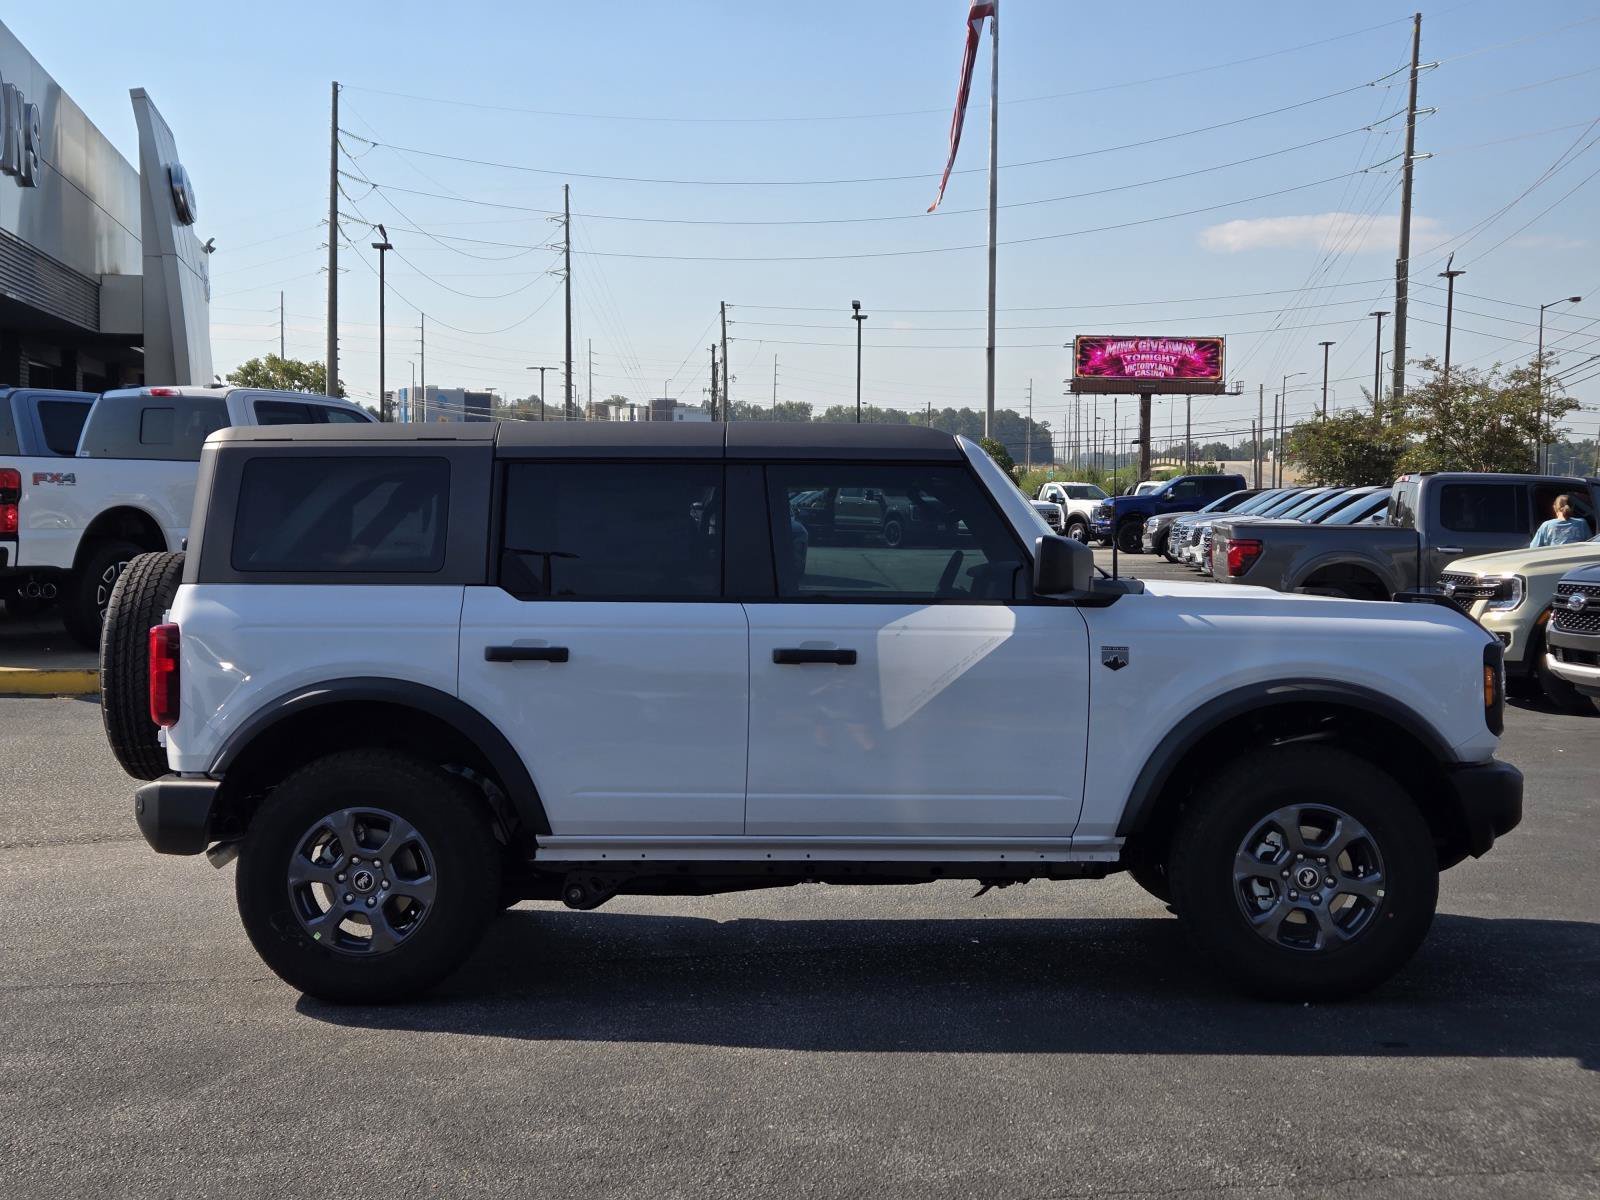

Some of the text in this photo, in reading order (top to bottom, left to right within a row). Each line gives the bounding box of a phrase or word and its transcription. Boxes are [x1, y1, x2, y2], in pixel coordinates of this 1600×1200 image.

[0, 68, 41, 188] NS
[1105, 341, 1136, 356] MINK
[1125, 354, 1177, 362] TONIGHT
[1124, 363, 1174, 375] VICTORYLAND
[32, 472, 76, 485] FX4
